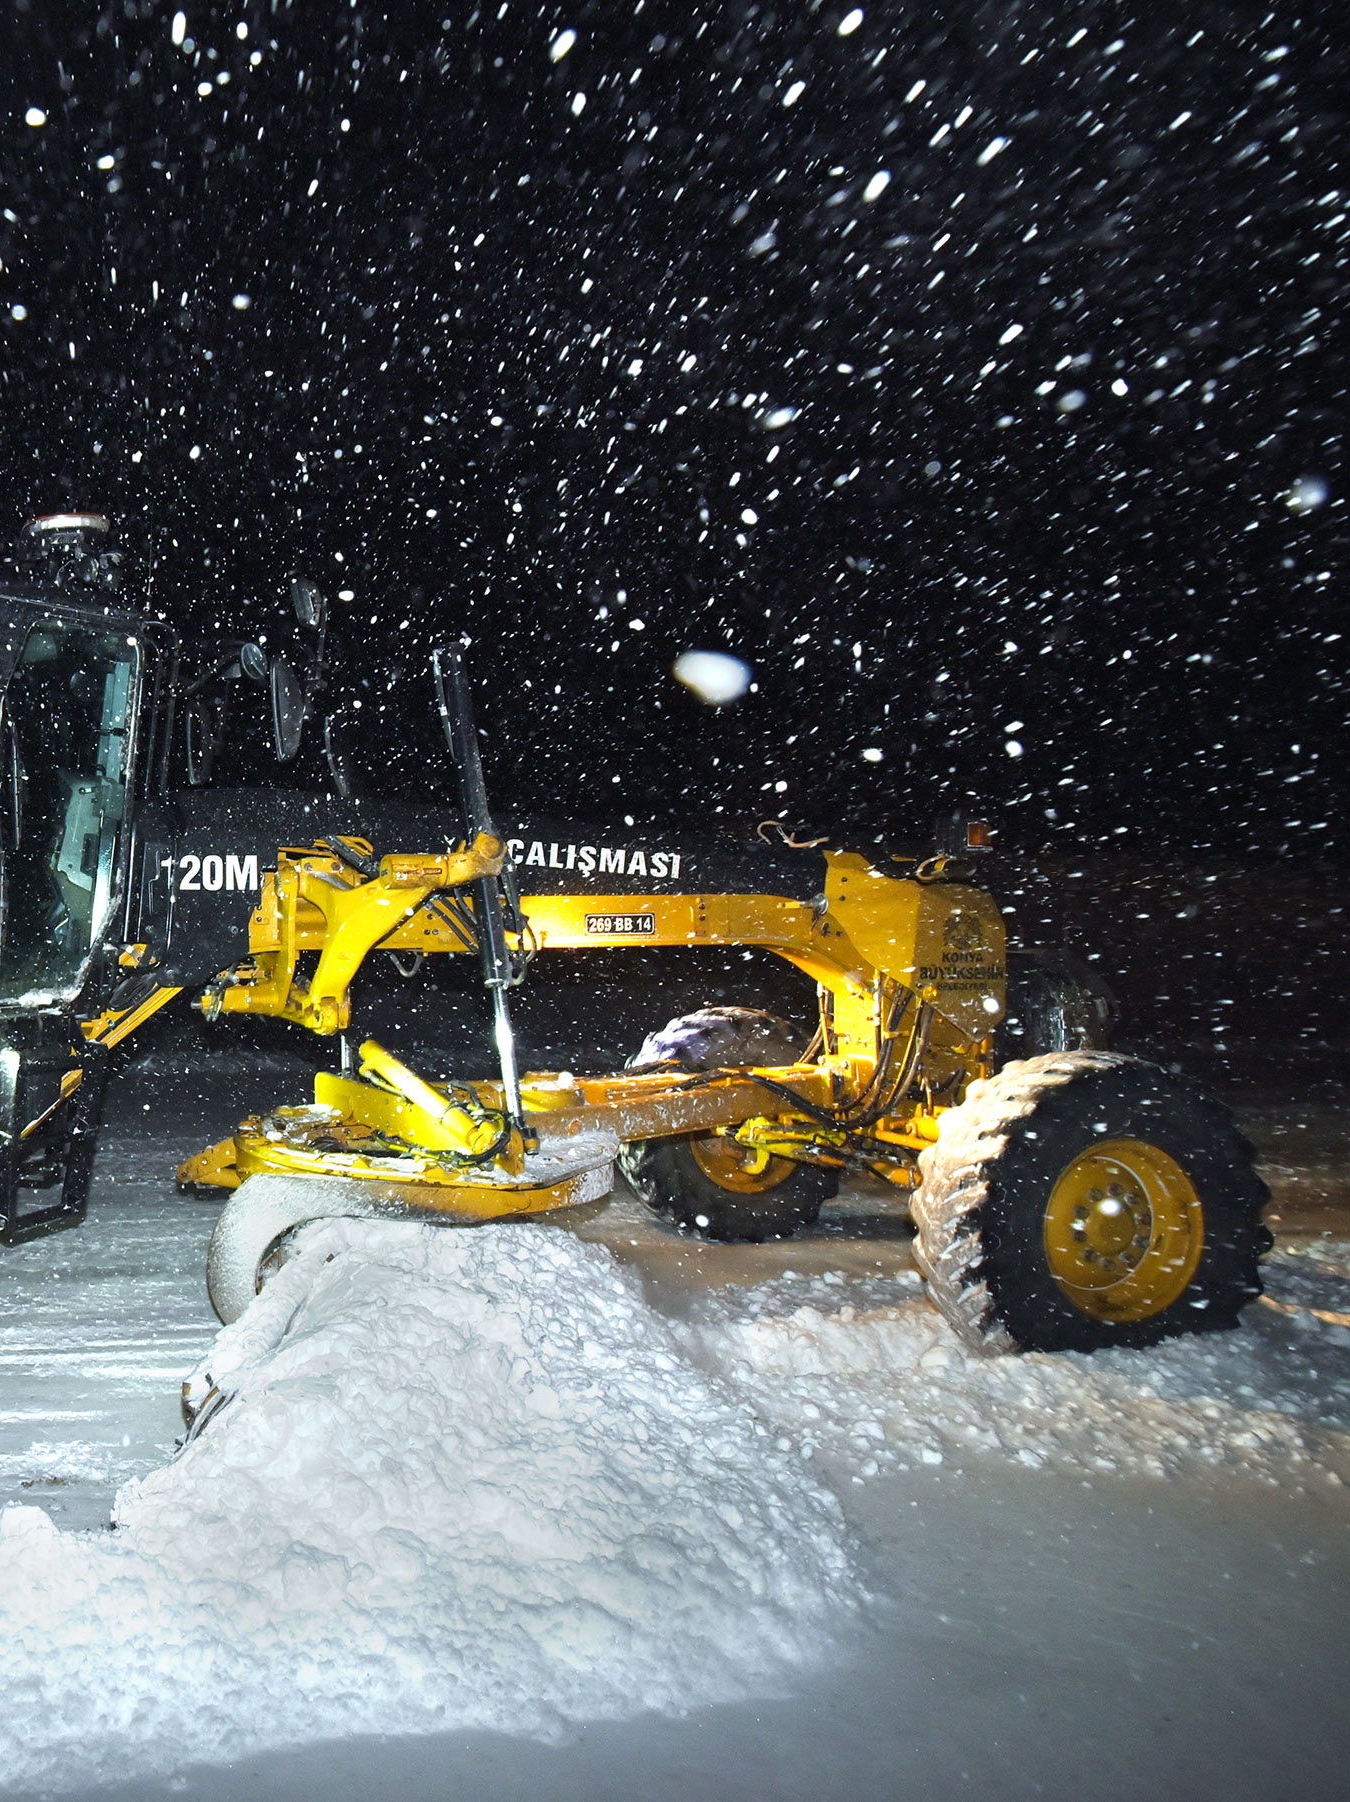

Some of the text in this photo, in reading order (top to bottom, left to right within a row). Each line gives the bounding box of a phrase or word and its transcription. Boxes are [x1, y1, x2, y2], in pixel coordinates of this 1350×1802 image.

[161, 854, 258, 891] 120M
[587, 917, 651, 932] 269 BB 14
[942, 952, 984, 962] KONYA
